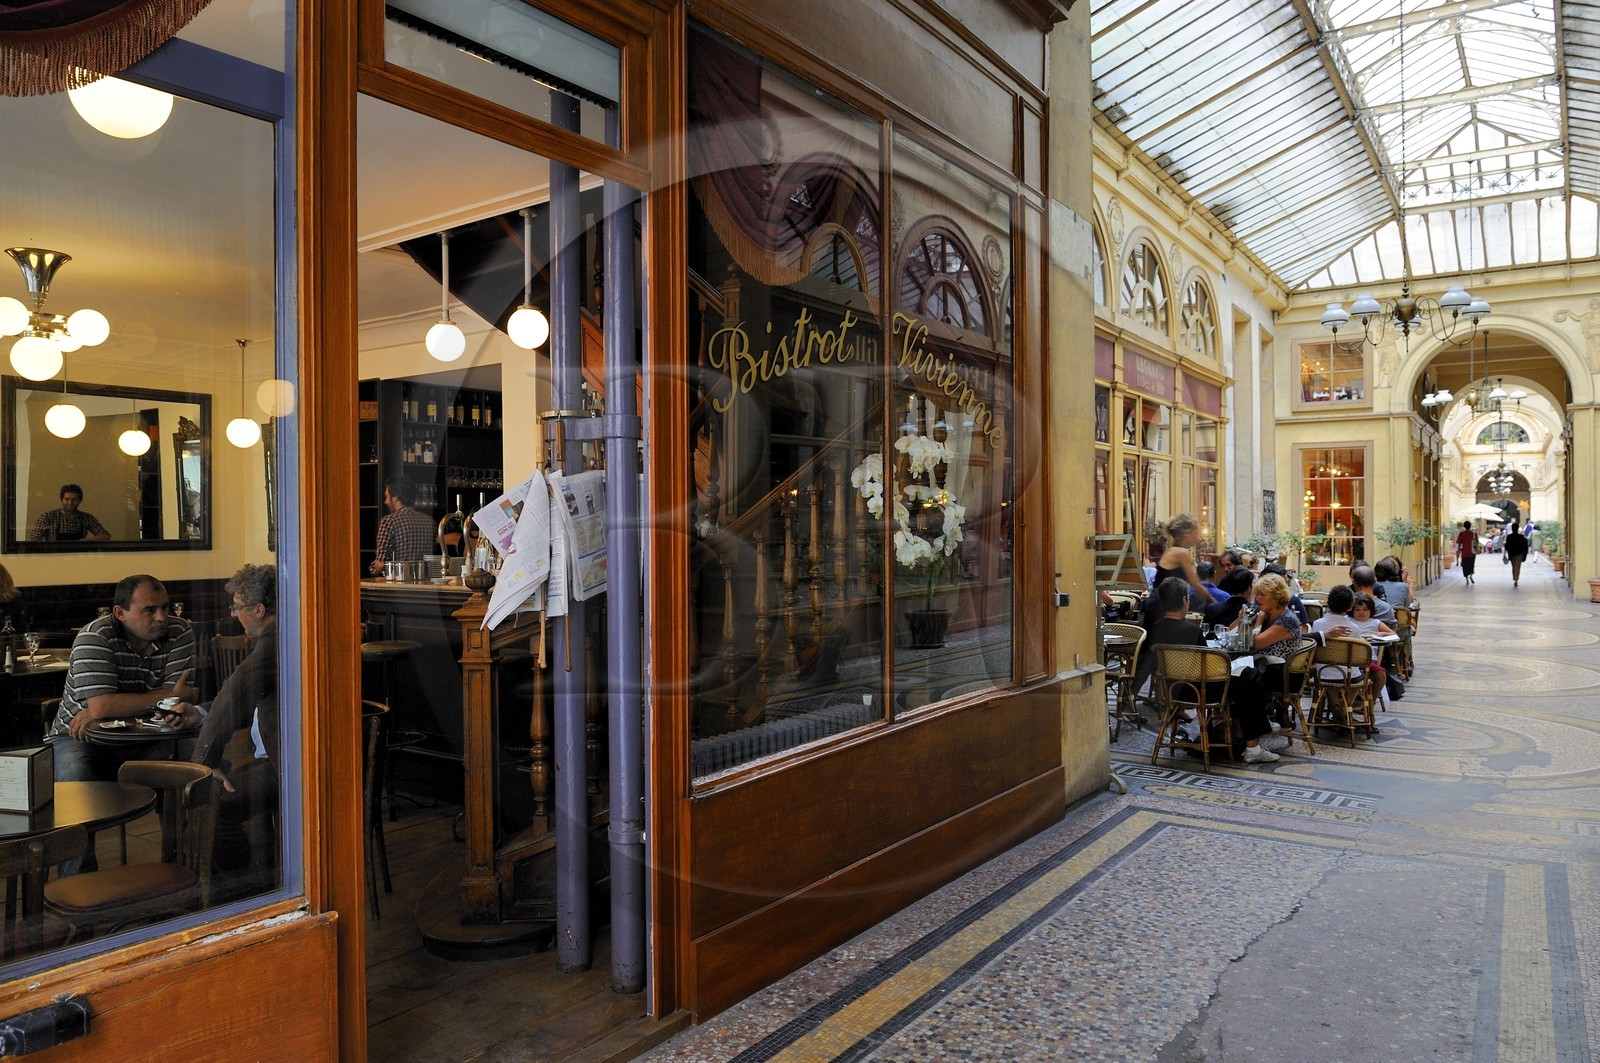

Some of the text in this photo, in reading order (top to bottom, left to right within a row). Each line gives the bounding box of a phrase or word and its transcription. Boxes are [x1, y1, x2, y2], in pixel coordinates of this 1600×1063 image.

[708, 307, 1006, 450] Bistrot Vivienne
[1180, 793, 1317, 816] MOSAISTE
